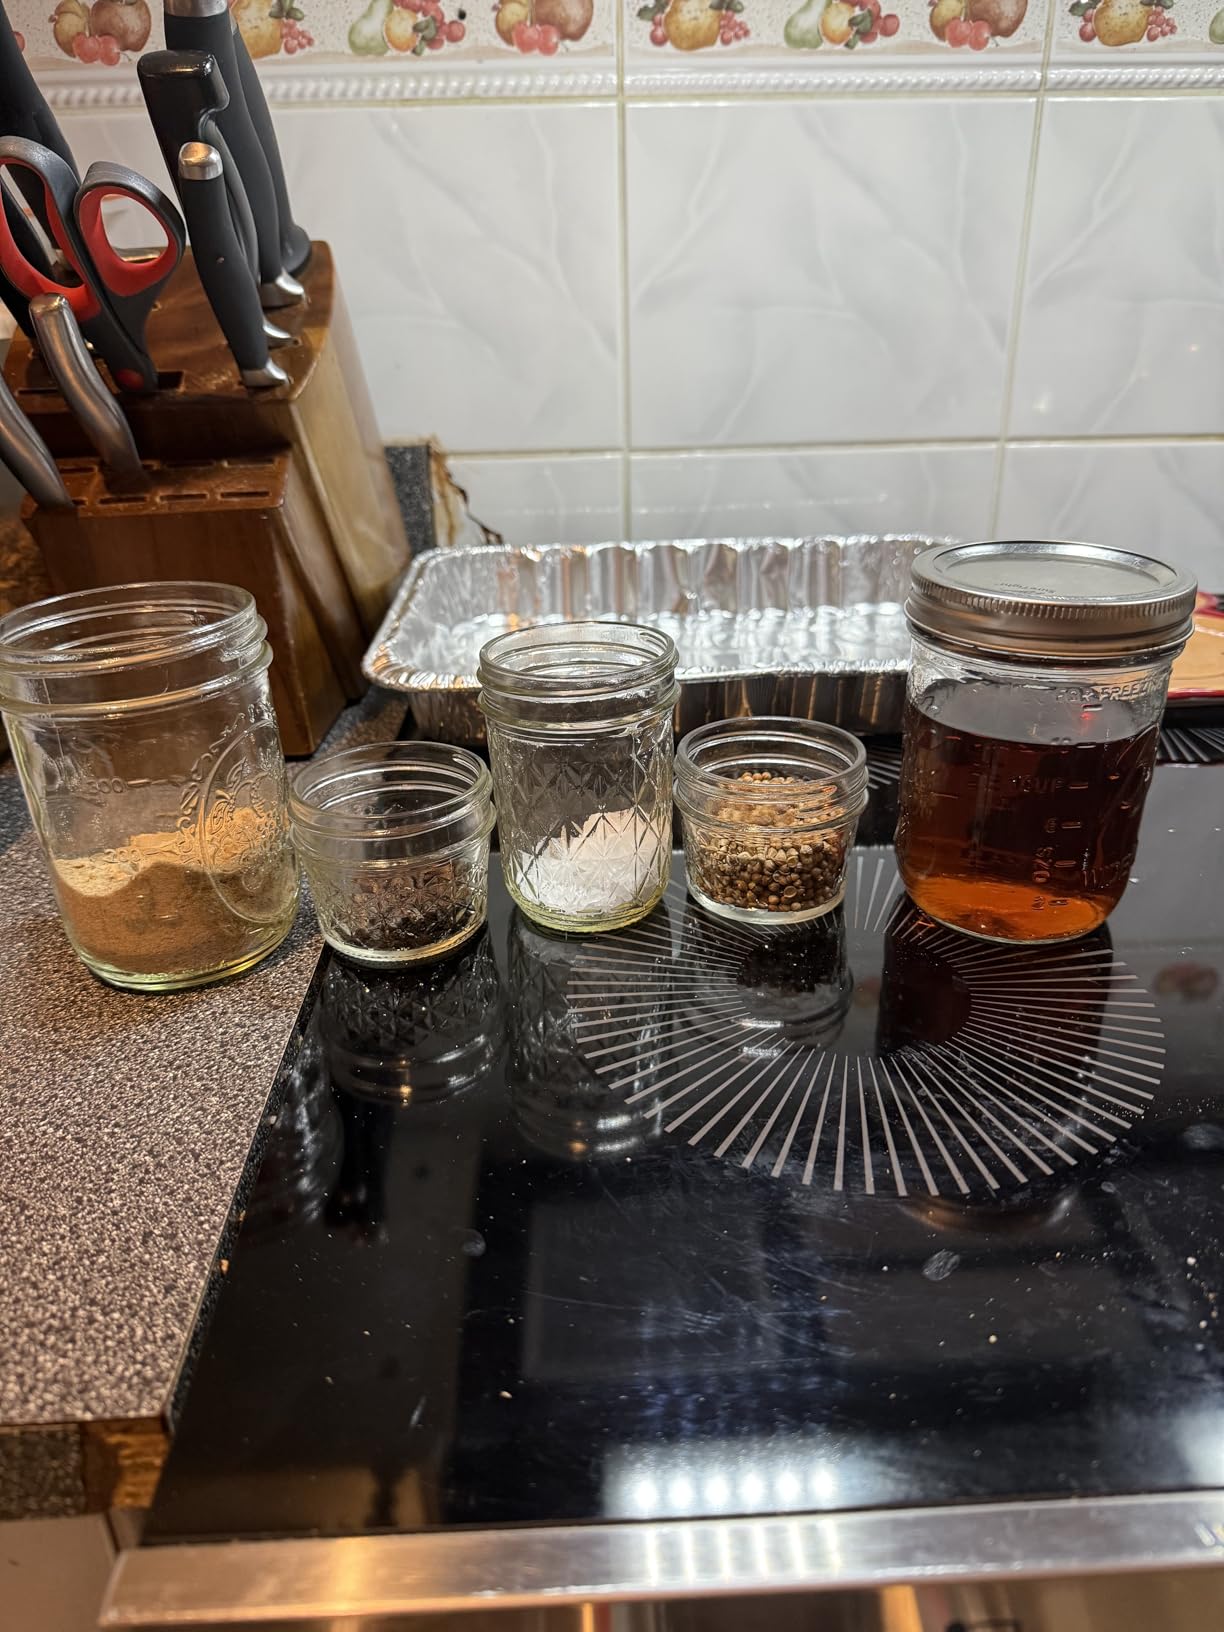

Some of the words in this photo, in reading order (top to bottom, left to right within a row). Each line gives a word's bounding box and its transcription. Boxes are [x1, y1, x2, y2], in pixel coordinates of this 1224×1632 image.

[1056, 687, 1094, 702] FOR
[86, 776, 127, 795] 300
[105, 847, 141, 864] 200
